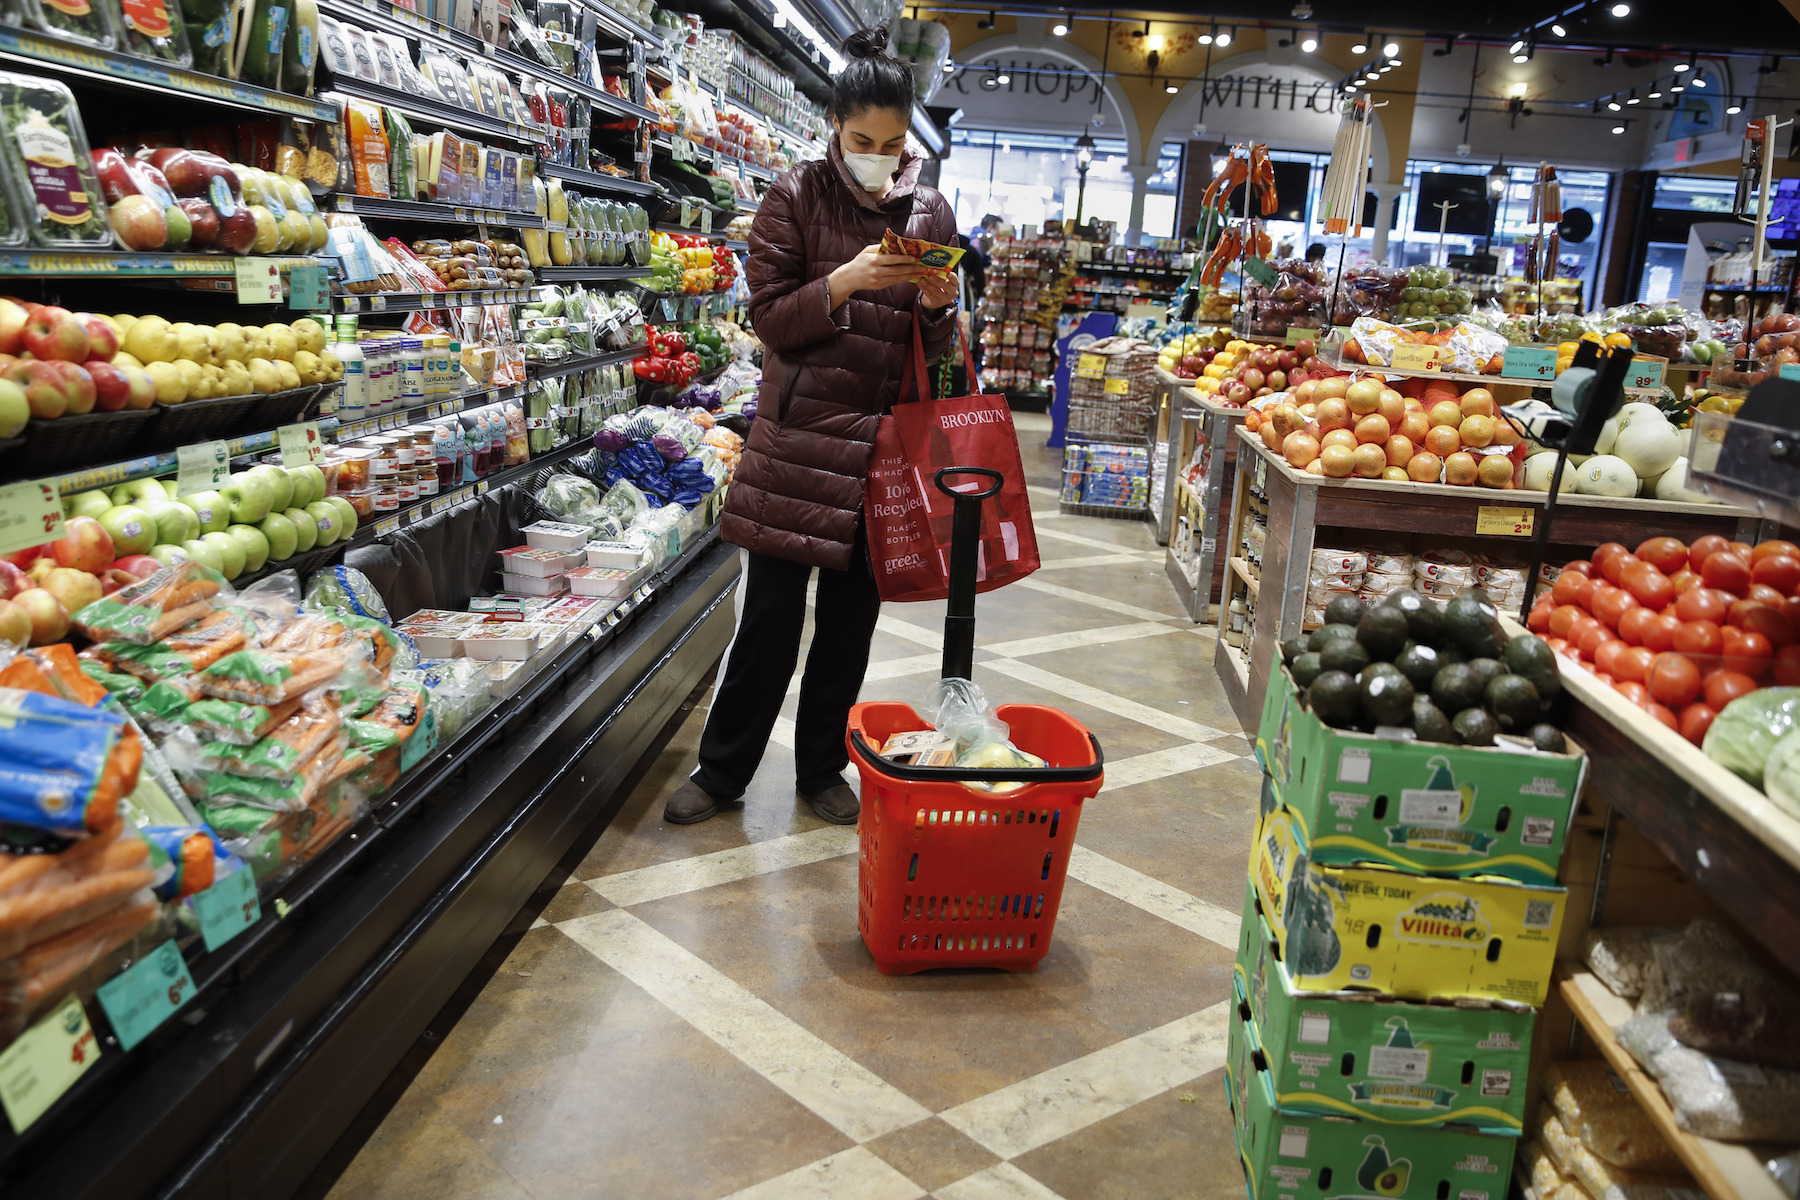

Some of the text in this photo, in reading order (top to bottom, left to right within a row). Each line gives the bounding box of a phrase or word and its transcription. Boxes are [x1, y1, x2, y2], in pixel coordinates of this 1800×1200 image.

[17, 37, 112, 71] ORGANIC
[169, 71, 237, 99] ORGANIC
[1203, 75, 1298, 111] WITH
[264, 94, 317, 117] ORGANIC
[29, 254, 118, 271] ORGANIC
[938, 349, 955, 399] ISTAC
[940, 409, 1006, 429] BROOKLYN
[881, 457, 902, 466] THIS
[58, 463, 130, 492] RGANIC
[884, 468, 903, 477] MAD
[885, 481, 911, 499] 10%
[873, 495, 923, 518] Recyled
[887, 521, 917, 533] PLASTIC
[1514, 524, 1531, 533] 299
[886, 532, 921, 545] BOTTLES
[884, 552, 920, 575] green
[1362, 884, 1379, 896] ONE
[1381, 885, 1412, 900] TODAY
